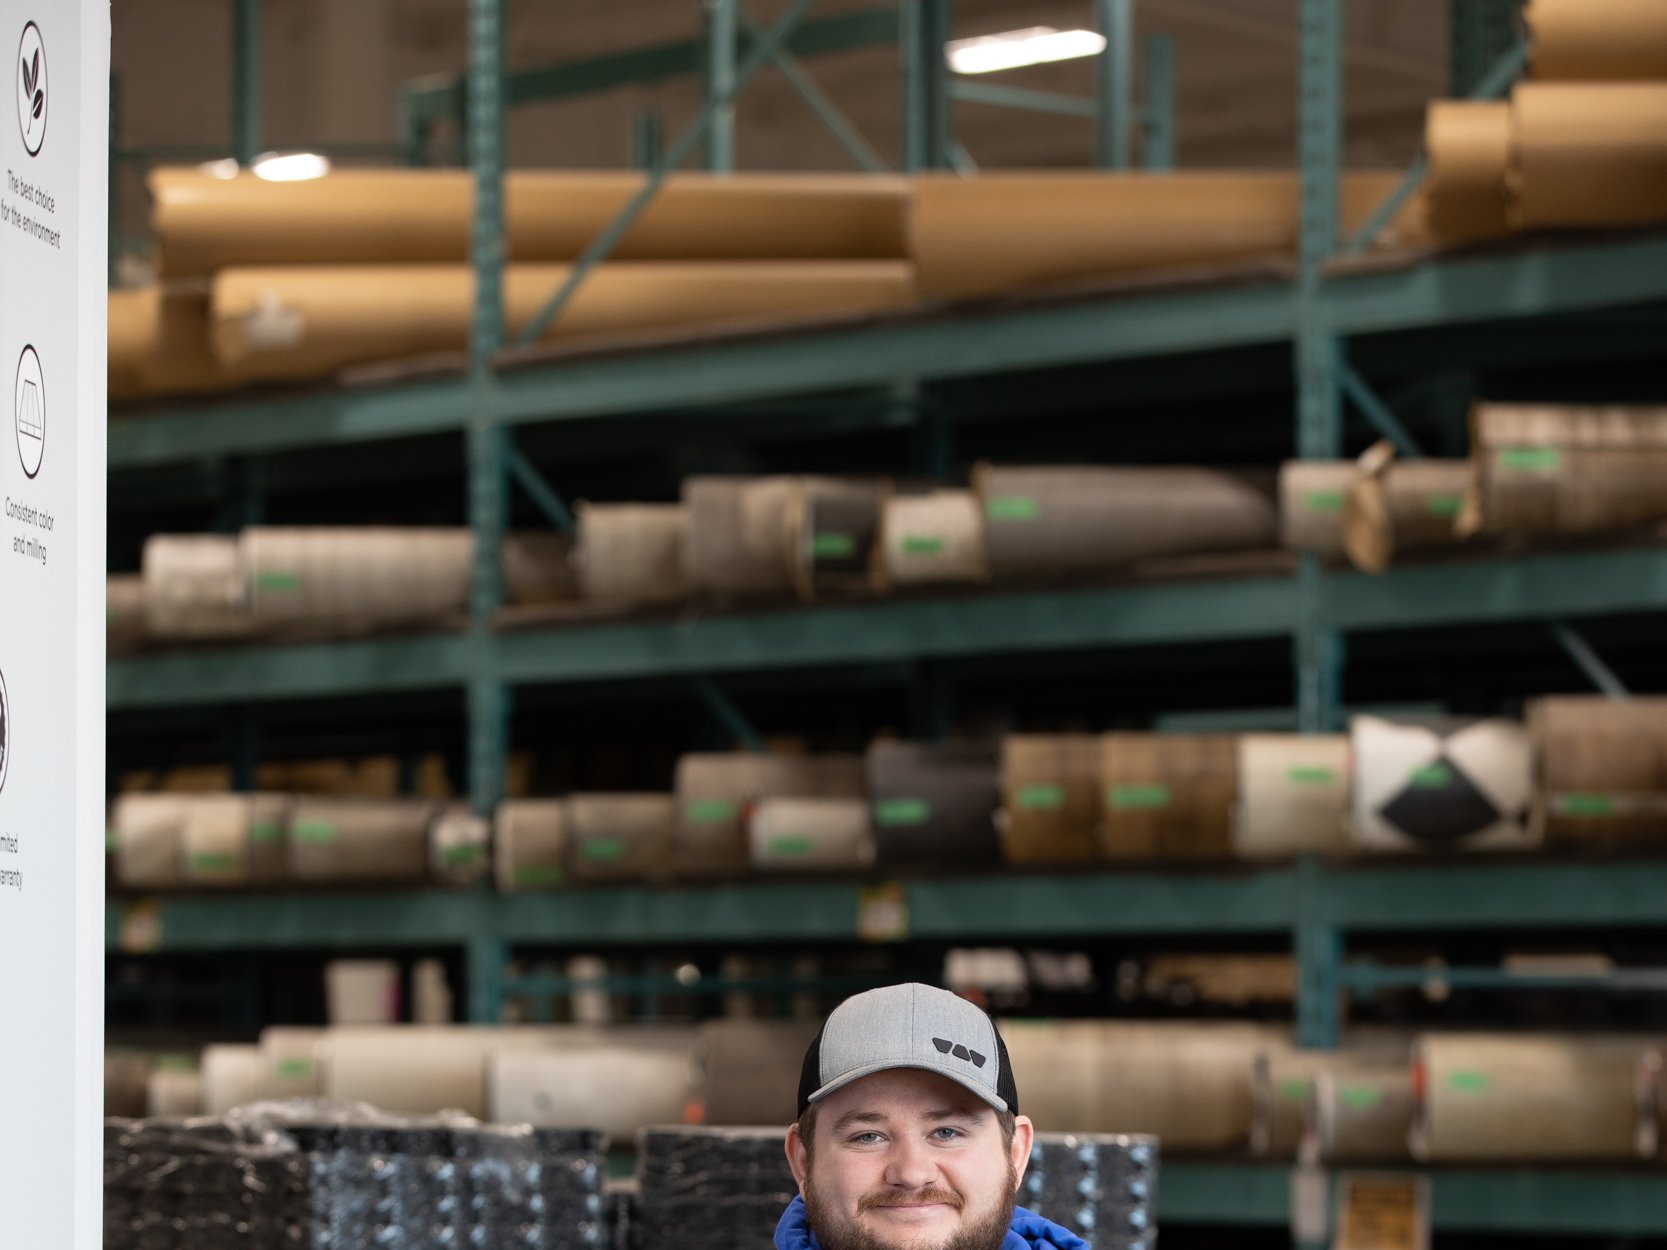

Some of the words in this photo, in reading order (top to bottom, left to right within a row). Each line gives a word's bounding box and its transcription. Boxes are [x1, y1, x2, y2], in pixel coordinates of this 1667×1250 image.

[8, 169, 19, 194] The
[21, 175, 34, 202] best
[35, 185, 55, 214] choice
[1, 198, 10, 222] for
[12, 205, 21, 229] the
[23, 215, 61, 250] environment
[6, 496, 38, 527] Consistent
[39, 509, 54, 532] color
[14, 533, 25, 555] and
[27, 537, 47, 566] milling
[0, 831, 19, 854] mited
[0, 867, 23, 892] arranty
